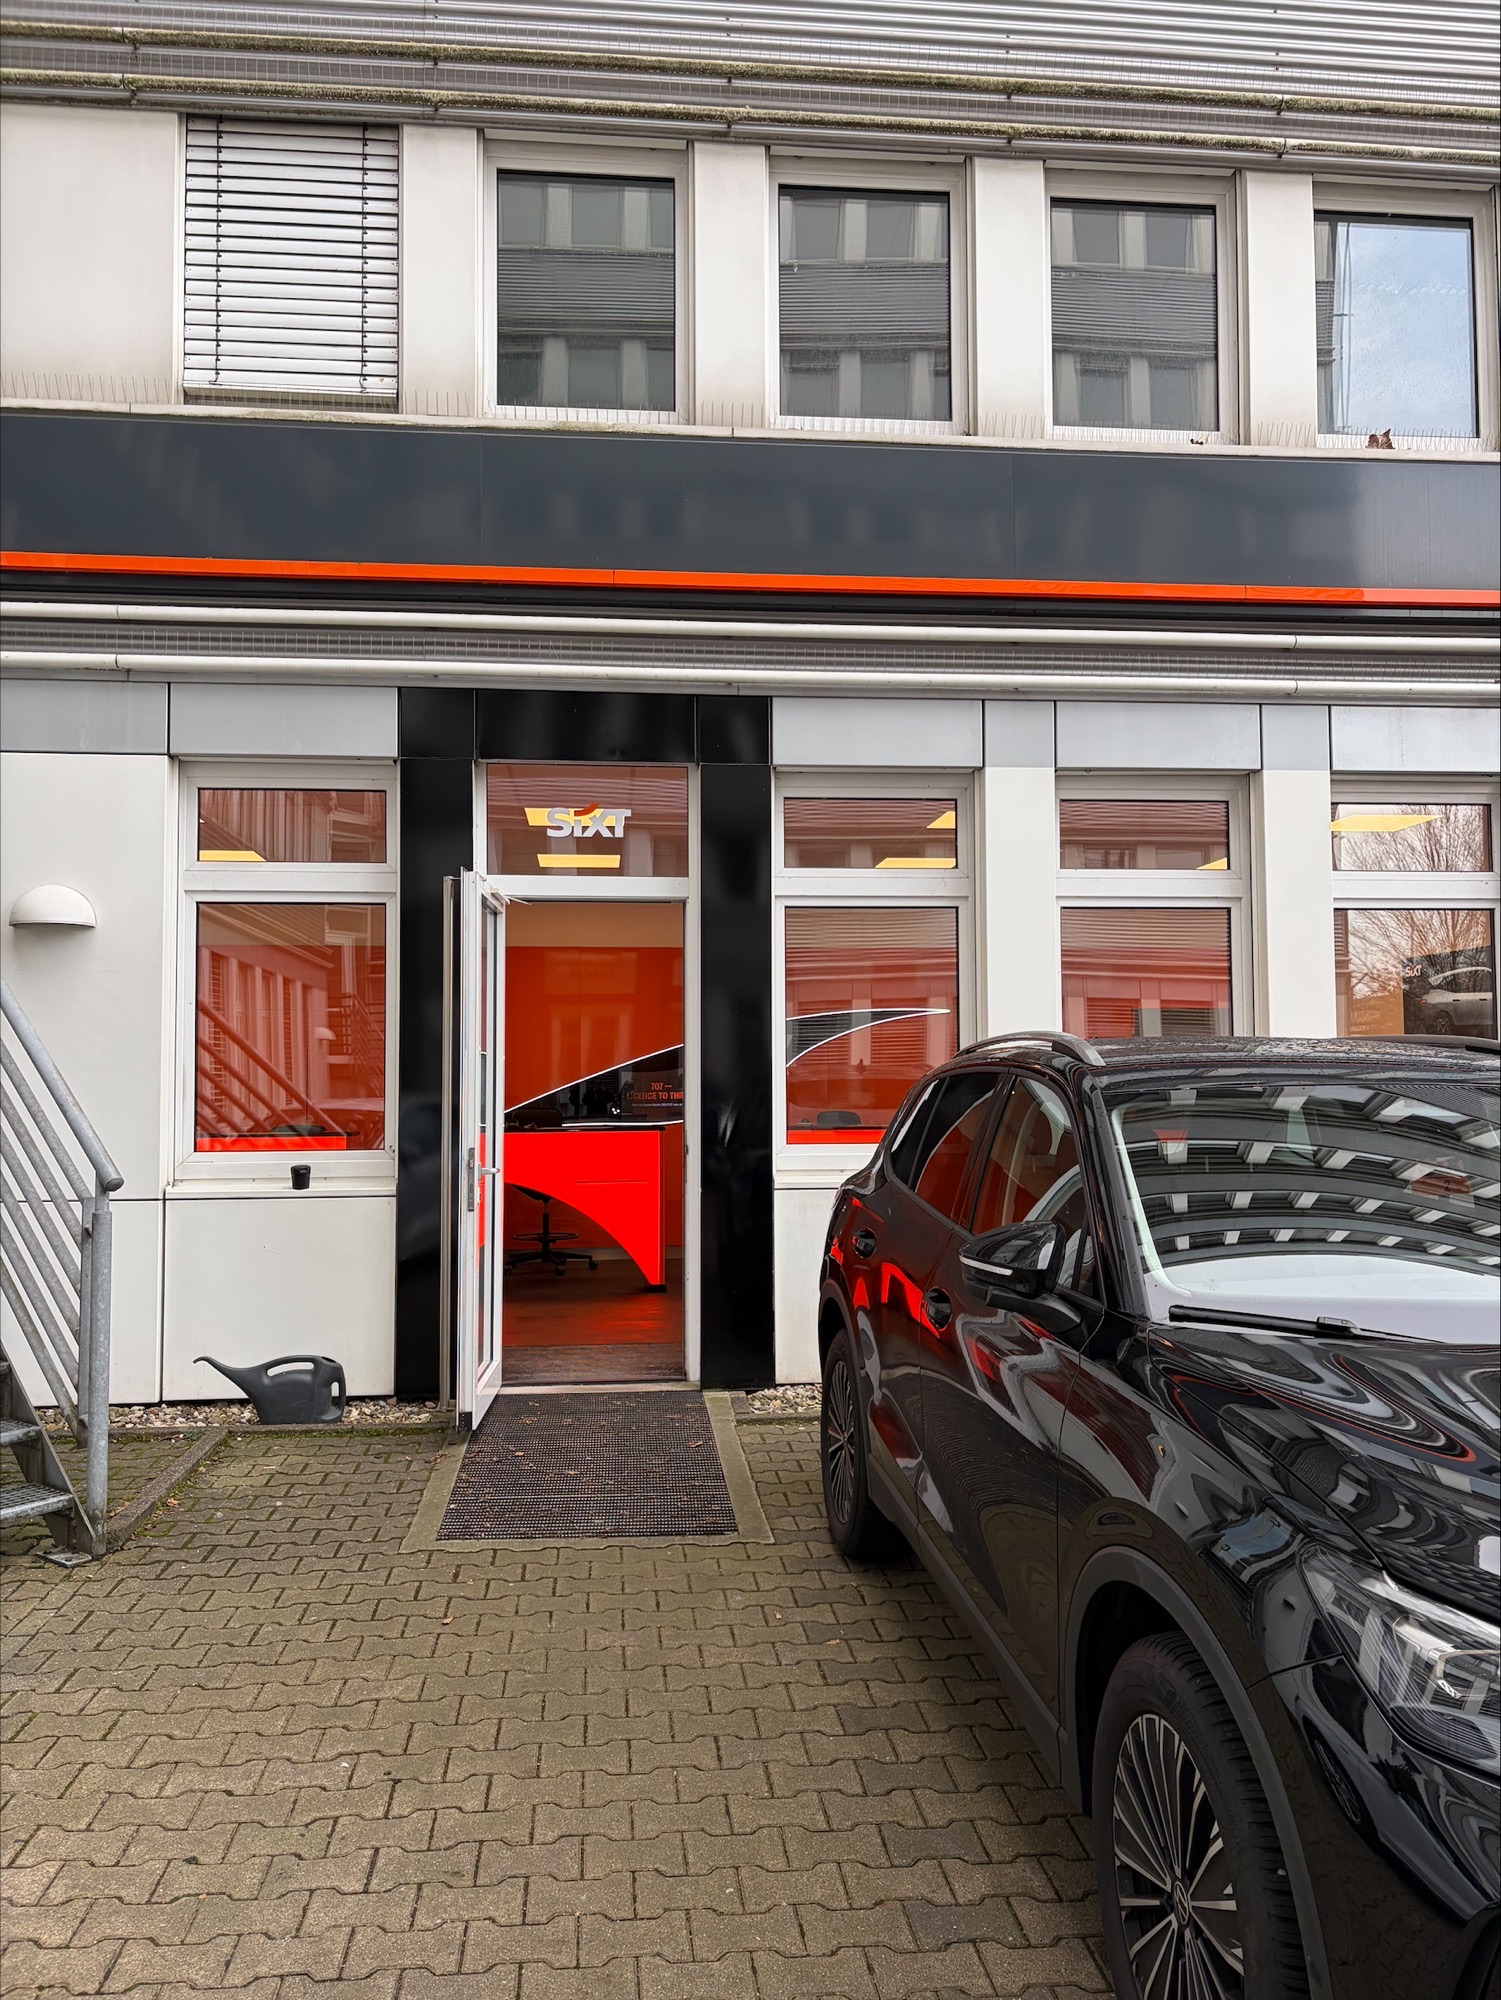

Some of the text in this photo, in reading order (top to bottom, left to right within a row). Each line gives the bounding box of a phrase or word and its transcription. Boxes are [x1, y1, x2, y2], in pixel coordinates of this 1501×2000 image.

[650, 1082, 664, 1091] 707
[626, 1091, 657, 1100] LICENCE
[658, 1091, 669, 1100] TO
